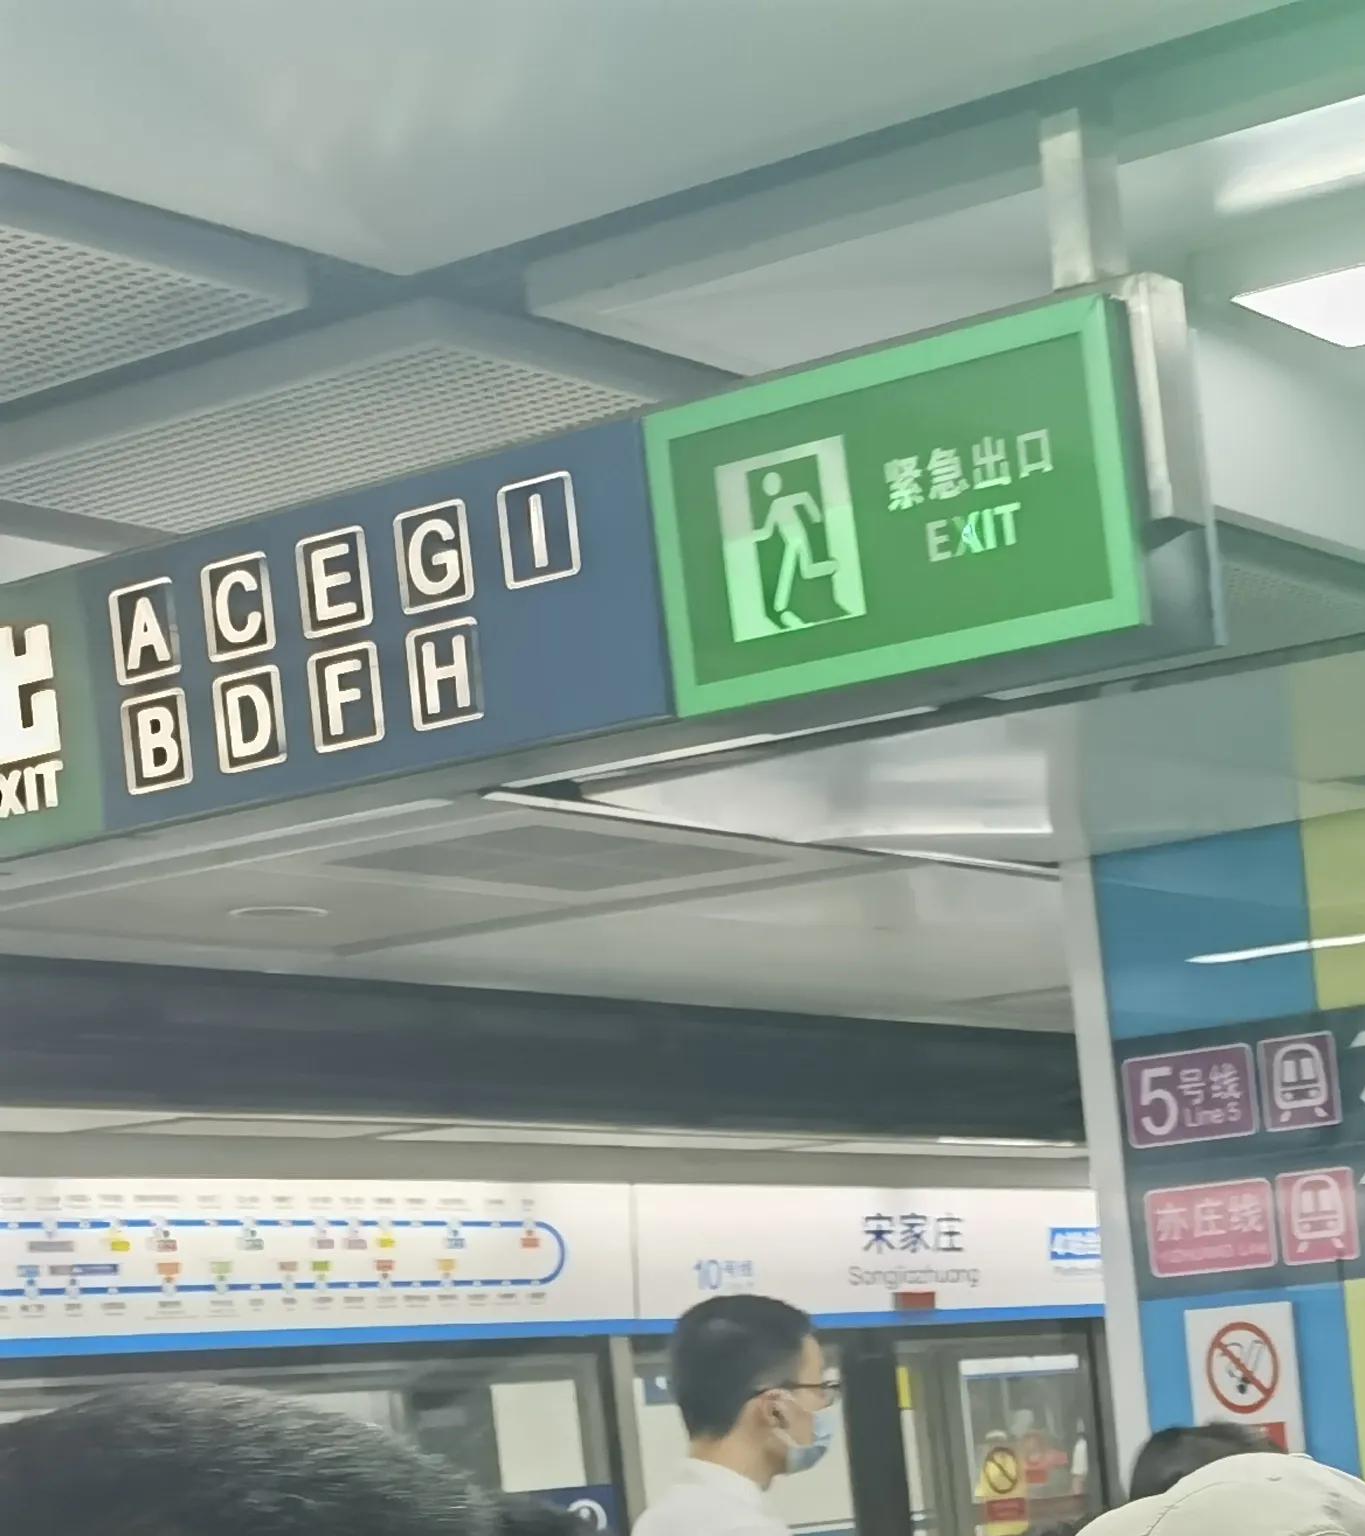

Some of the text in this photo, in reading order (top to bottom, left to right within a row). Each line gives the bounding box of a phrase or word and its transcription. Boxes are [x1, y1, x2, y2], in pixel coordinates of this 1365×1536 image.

[926, 502, 1021, 562] EXIT
[127, 493, 548, 669] A C E G I
[137, 636, 470, 778] B D F H
[0, 760, 63, 818] XIT
[862, 1212, 965, 1254] 宋家庄
